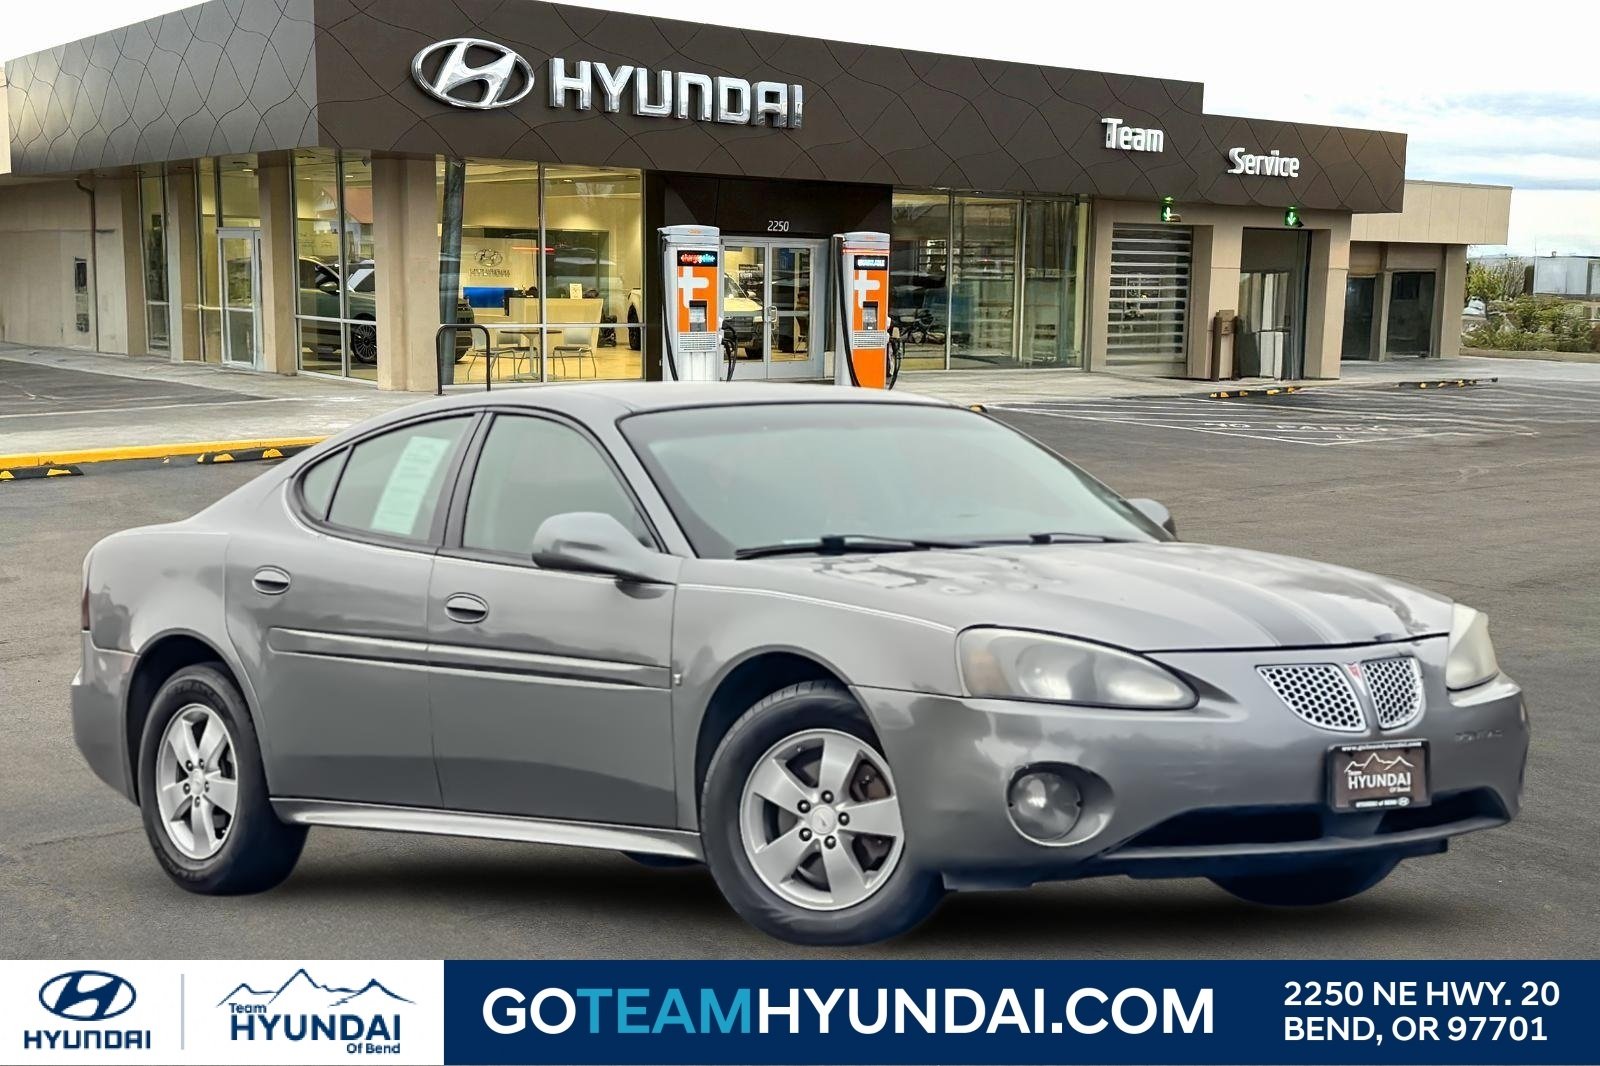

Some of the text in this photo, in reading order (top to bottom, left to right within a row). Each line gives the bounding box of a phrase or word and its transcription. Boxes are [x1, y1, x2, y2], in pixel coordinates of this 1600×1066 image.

[549, 57, 803, 129] HYUNDAI
[1101, 117, 1164, 153] Team
[1227, 147, 1300, 178] Service
[767, 220, 790, 232] 2250
[1348, 772, 1411, 790] HYUNDAI
